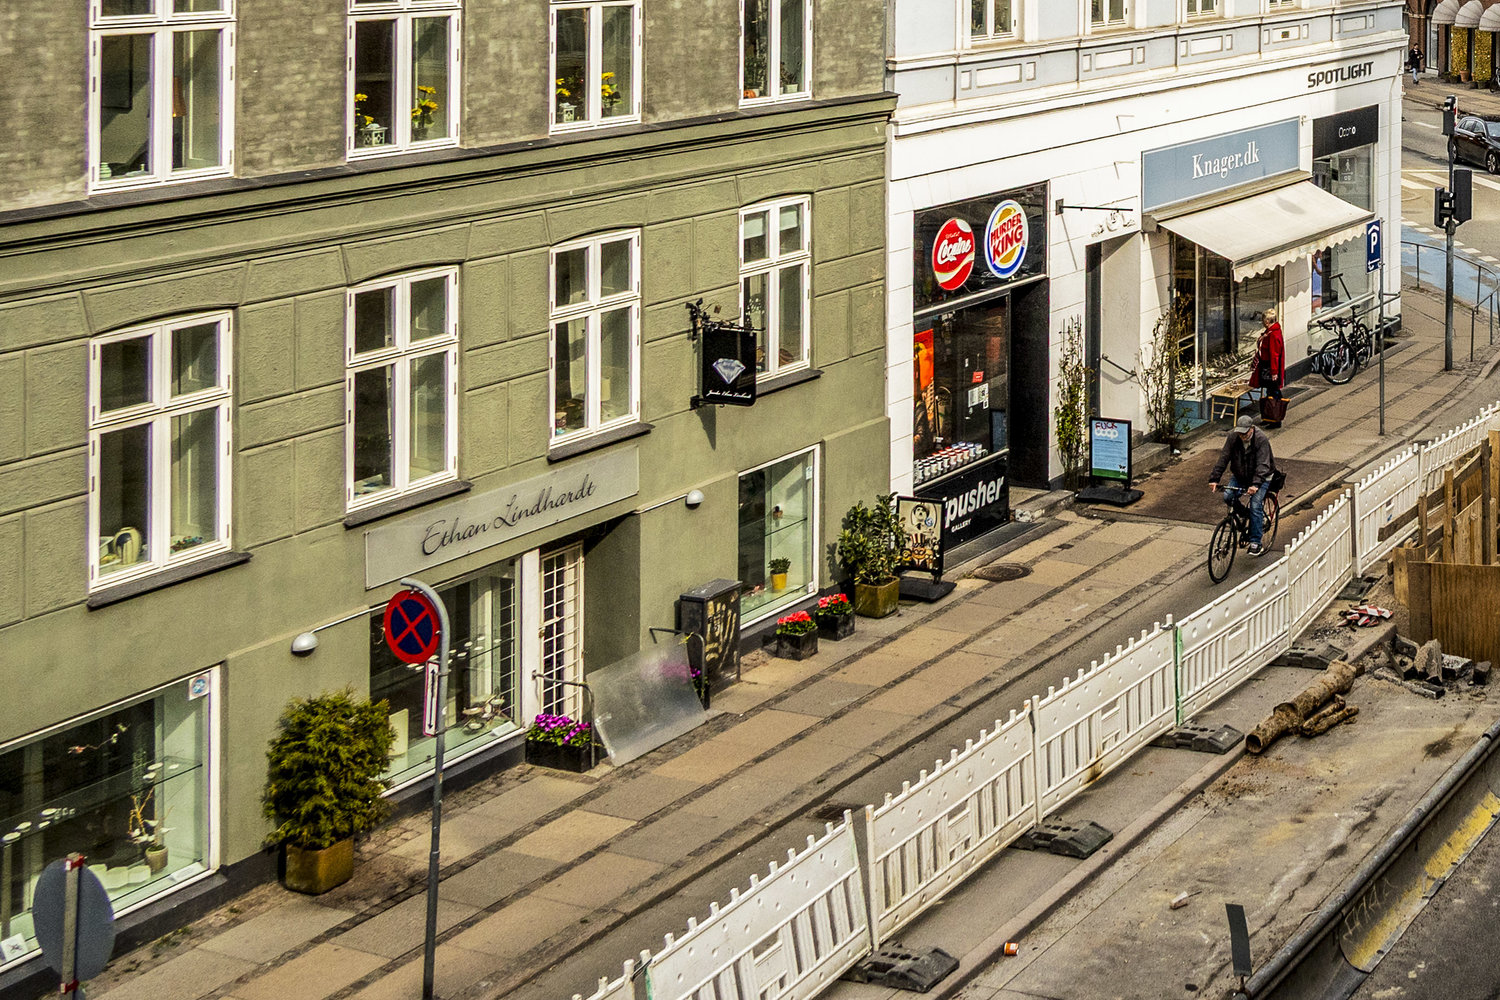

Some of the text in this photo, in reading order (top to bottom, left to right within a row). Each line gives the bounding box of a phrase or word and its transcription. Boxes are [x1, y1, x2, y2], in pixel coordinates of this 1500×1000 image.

[1308, 62, 1374, 88] SPOTLIGHT
[1192, 141, 1259, 179] Knager.dk
[993, 224, 1024, 263] KING
[1371, 232, 1378, 254] P
[951, 518, 971, 532] GALLERY
